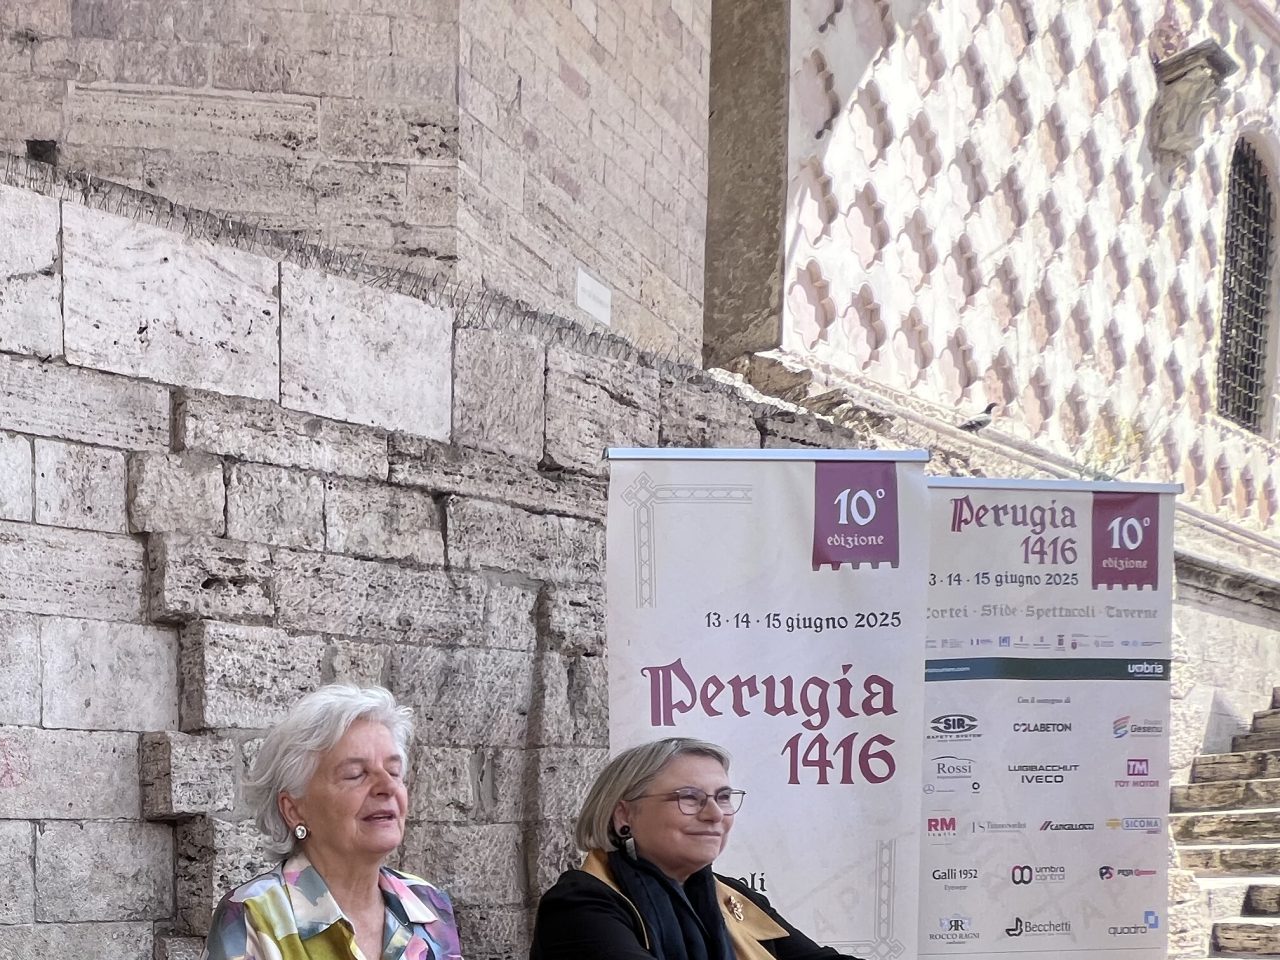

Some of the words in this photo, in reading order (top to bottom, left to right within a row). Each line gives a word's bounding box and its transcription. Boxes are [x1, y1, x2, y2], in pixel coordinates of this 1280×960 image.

[950, 495, 1077, 535] Perugia
[826, 533, 885, 548] edizione
[1020, 535, 1078, 565] 1416
[1102, 558, 1148, 570] edizione
[928, 573, 937, 585] 3
[947, 573, 962, 585] 14
[975, 572, 990, 585] 15
[995, 573, 1041, 587] giugno
[1045, 573, 1079, 585] 2025
[927, 605, 968, 619] ortei
[1025, 605, 1096, 619] Spettacoli
[1105, 605, 1158, 618] Taverne
[704, 612, 722, 629] 13
[734, 612, 751, 629] 14
[765, 612, 782, 629] 15
[785, 613, 848, 632] giugno
[854, 611, 902, 628] 2025
[639, 657, 898, 731] Perugia
[943, 718, 966, 730] SIR
[1013, 722, 1072, 732] COLABETON
[780, 732, 896, 785] 1416
[937, 761, 972, 774] Rossi
[1128, 760, 1148, 775] TM
[1021, 775, 1064, 783] IVECO
[927, 818, 956, 831] RM
[1125, 819, 1159, 828] SICOMA
[932, 869, 957, 880] Galli
[959, 869, 978, 879] 1952
[1024, 921, 1071, 933] Becchetti
